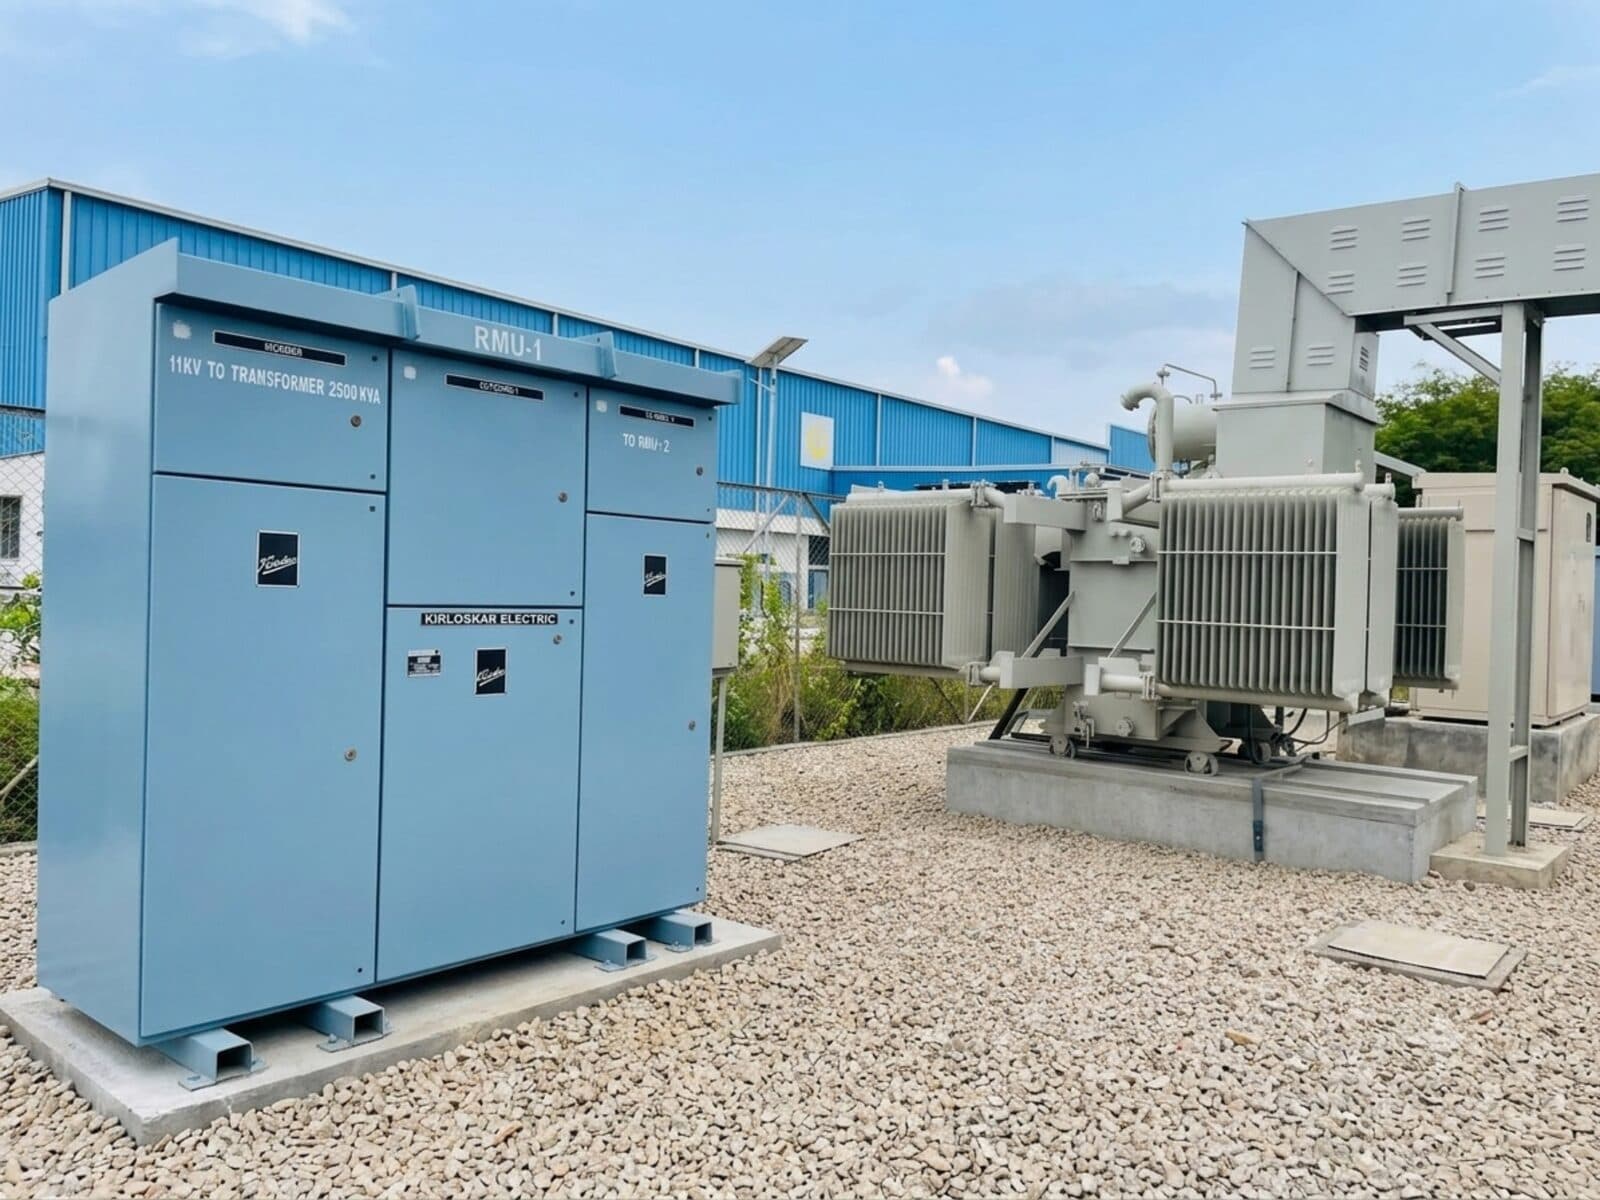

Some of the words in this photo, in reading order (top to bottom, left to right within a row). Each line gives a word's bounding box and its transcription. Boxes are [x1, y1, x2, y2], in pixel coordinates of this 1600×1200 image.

[474, 325, 541, 361] RMU-1
[169, 355, 201, 376] 11KV
[207, 361, 225, 379] TO
[231, 364, 325, 395] TRANSFORMER
[329, 381, 358, 401] 2500
[359, 386, 381, 405] KVA
[622, 433, 636, 448] TO
[424, 613, 497, 624] KIRLOSKAR
[500, 614, 556, 624] ELECTRIC
